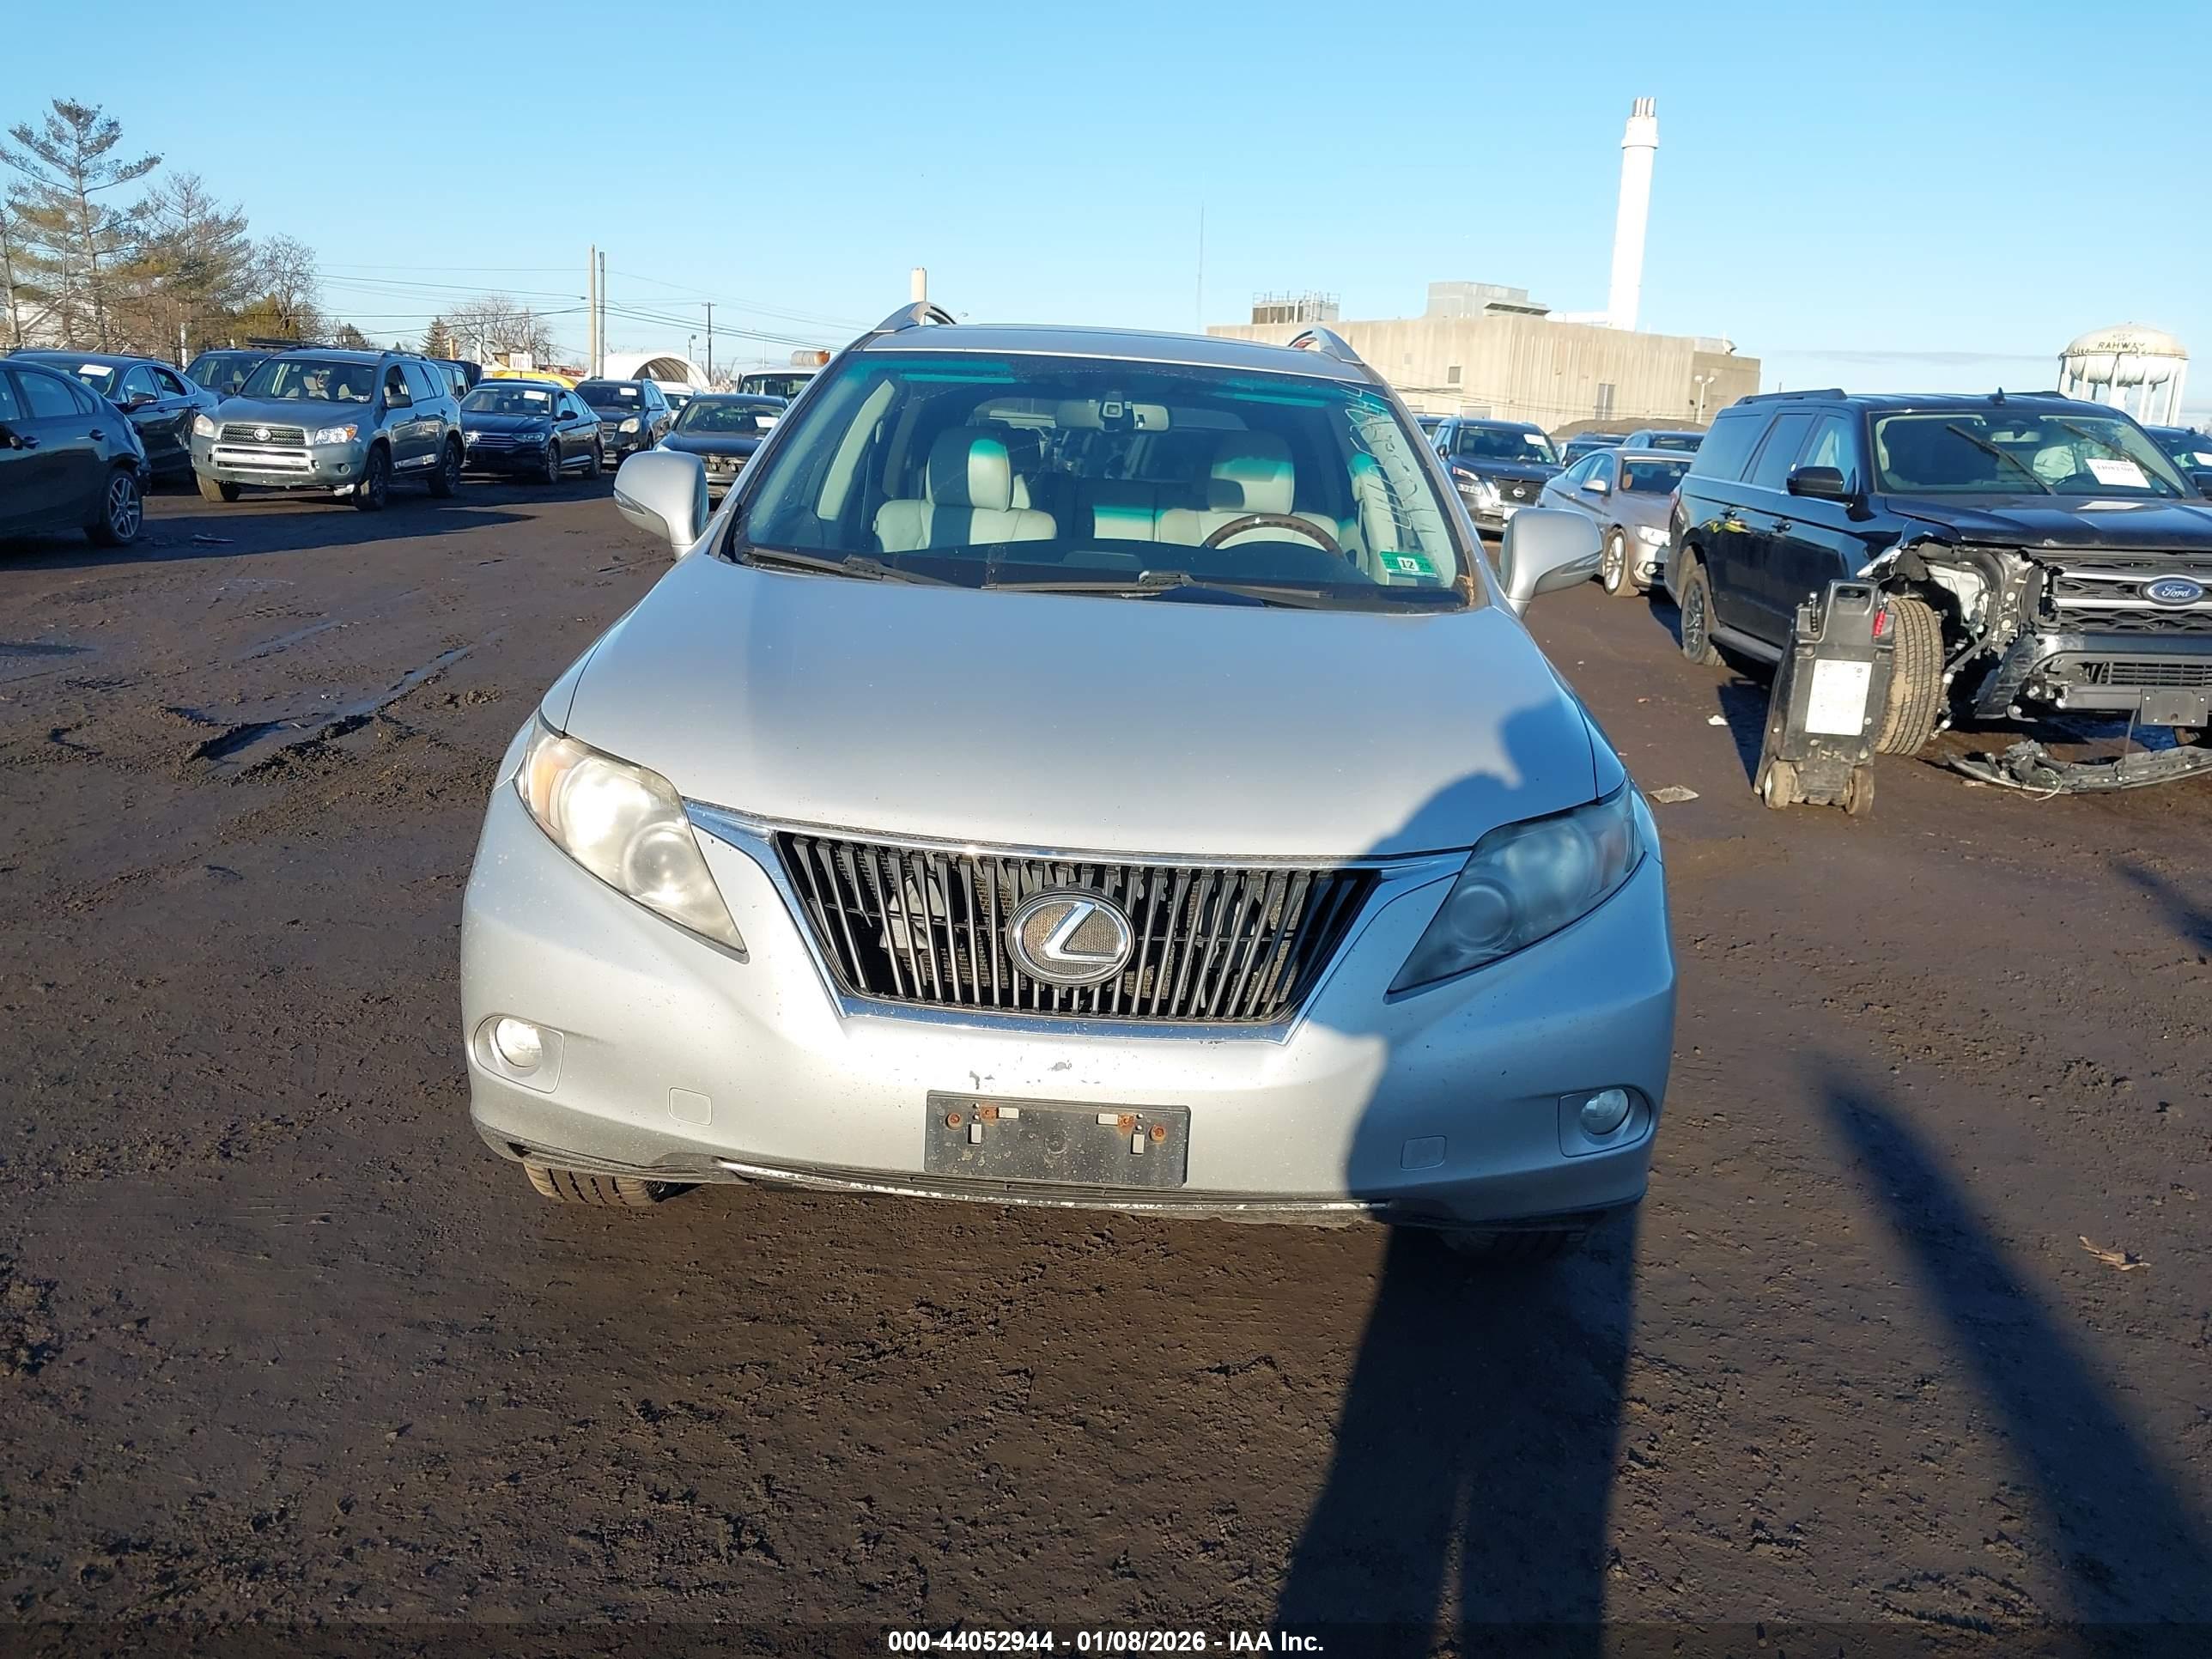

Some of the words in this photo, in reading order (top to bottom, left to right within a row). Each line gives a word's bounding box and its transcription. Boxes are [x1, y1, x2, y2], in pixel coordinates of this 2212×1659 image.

[2097, 341, 2147, 350] RAHWAY
[1401, 559, 1416, 570] 12
[2161, 584, 2191, 598] Ford
